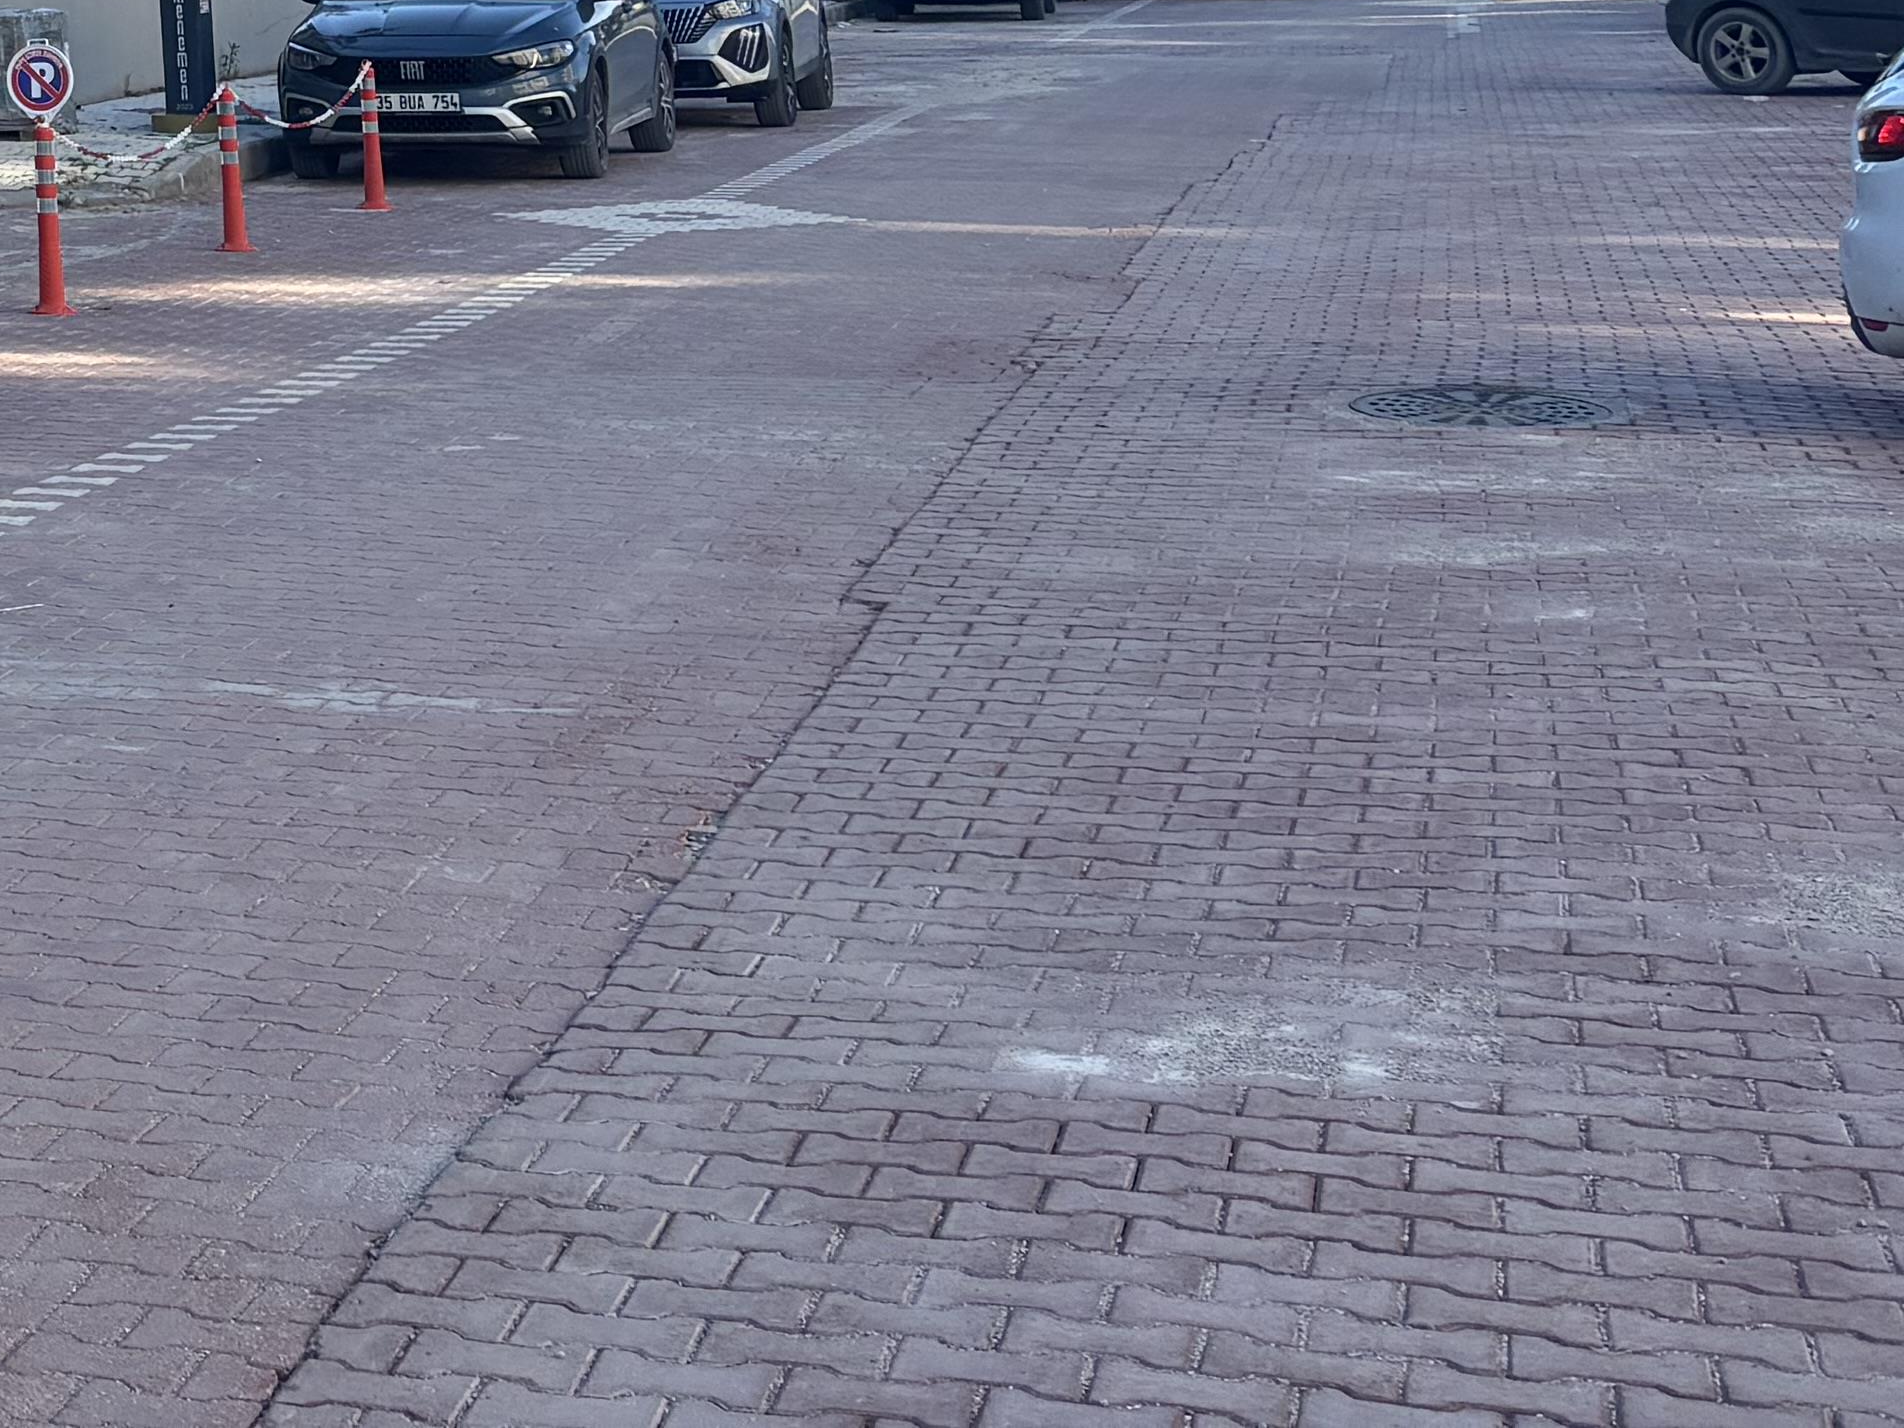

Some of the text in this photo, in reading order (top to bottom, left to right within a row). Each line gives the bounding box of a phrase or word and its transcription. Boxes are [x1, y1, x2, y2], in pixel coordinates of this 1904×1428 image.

[400, 61, 425, 80] FIAT
[376, 95, 458, 110] 35 BUA 754
